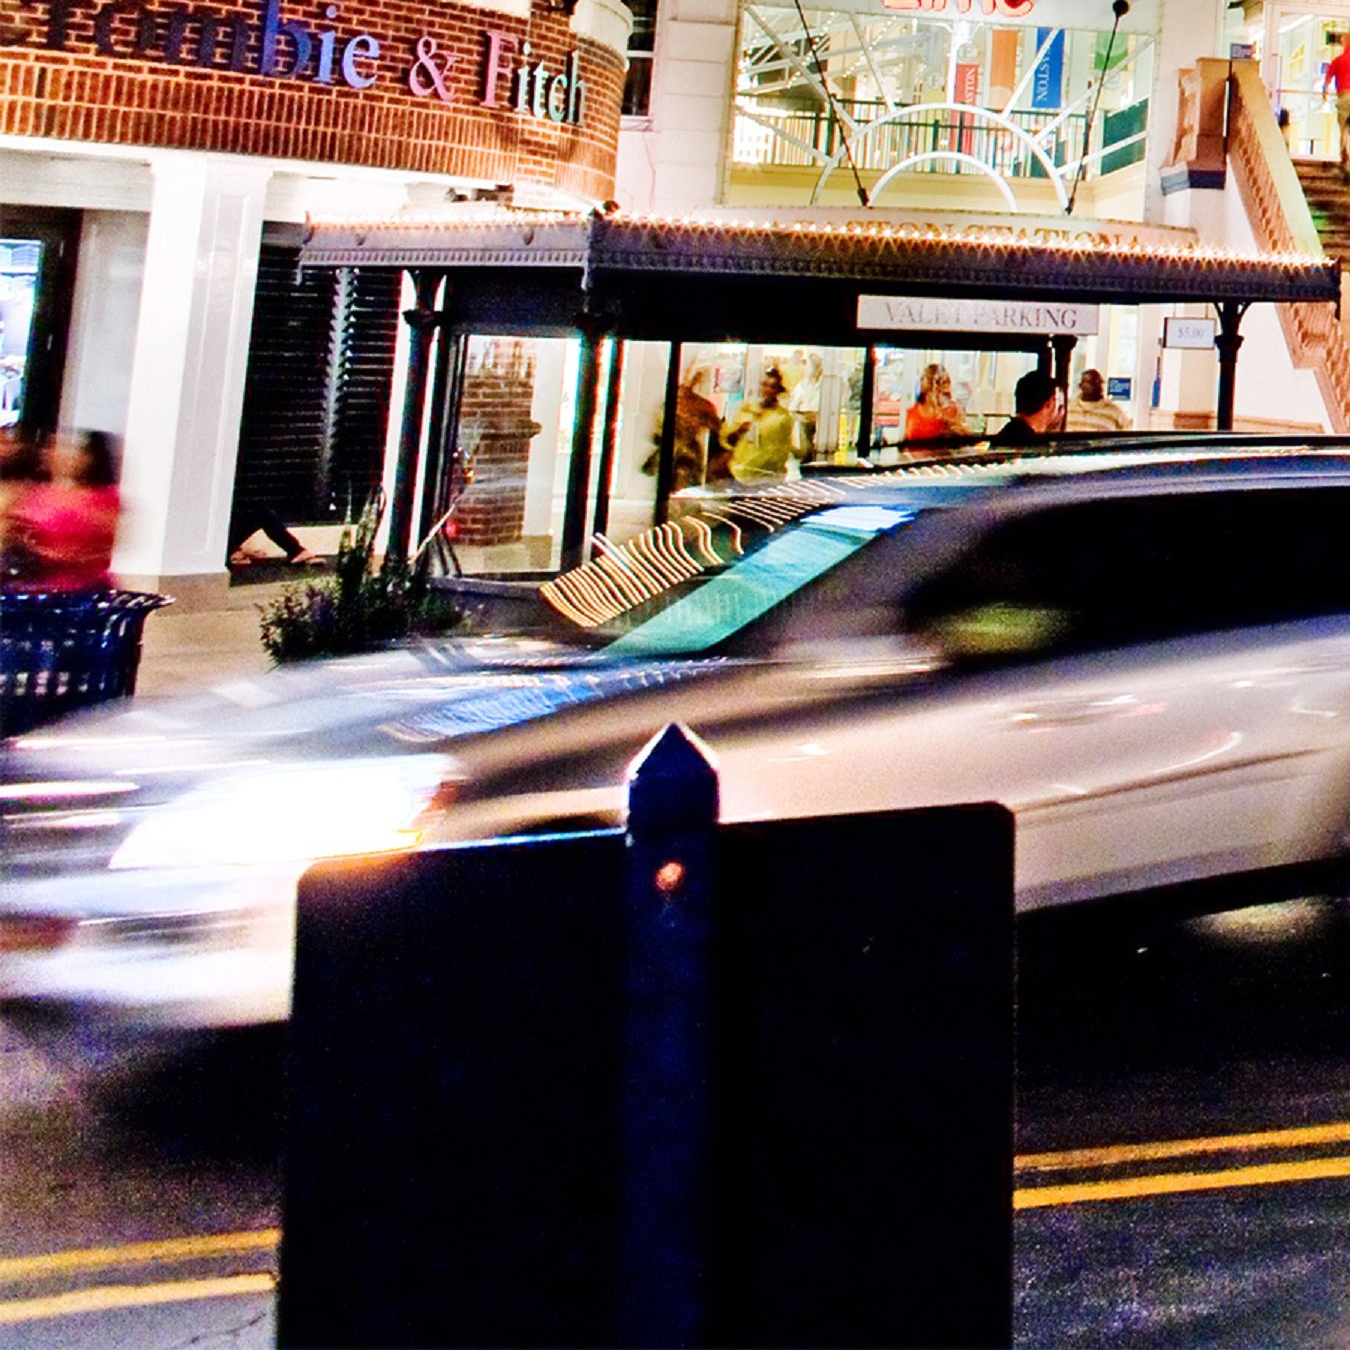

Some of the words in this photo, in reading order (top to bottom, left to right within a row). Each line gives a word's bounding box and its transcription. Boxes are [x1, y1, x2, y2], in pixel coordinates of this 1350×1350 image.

[408, 35, 461, 101] &
[479, 30, 586, 127] Fitch
[883, 301, 965, 326] VALET
[971, 304, 1079, 330] PARKING
